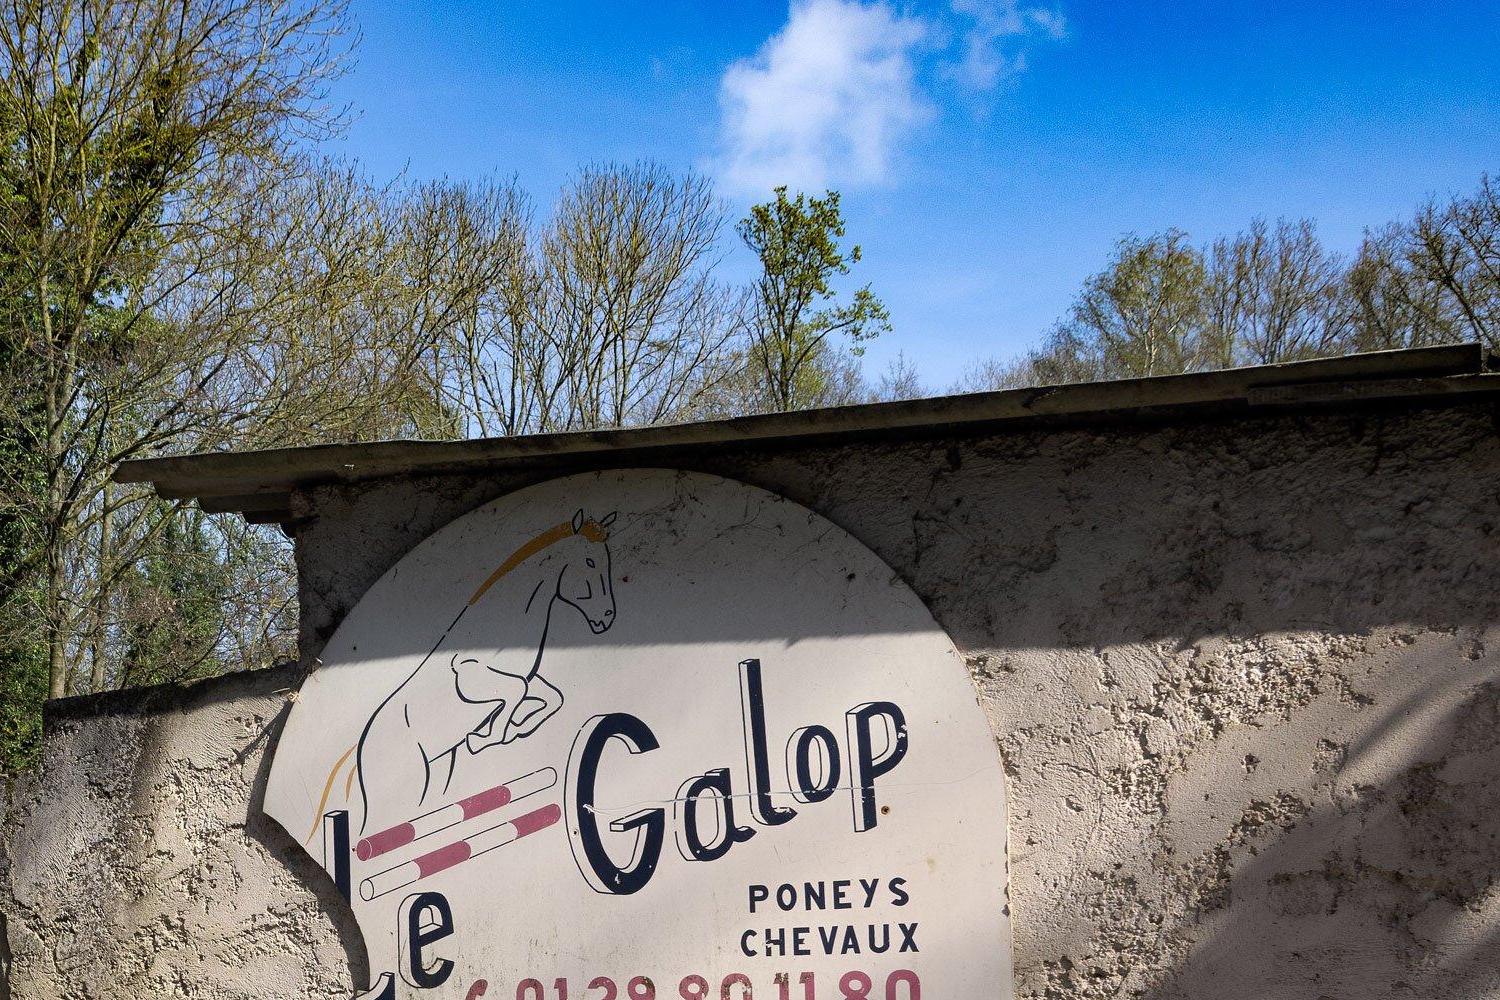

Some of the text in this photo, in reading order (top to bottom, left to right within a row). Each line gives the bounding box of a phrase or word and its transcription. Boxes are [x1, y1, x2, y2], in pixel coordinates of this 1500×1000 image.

[563, 658, 909, 896] Galop
[749, 878, 911, 913] PONEYS
[741, 922, 919, 957] CHEVAUX
